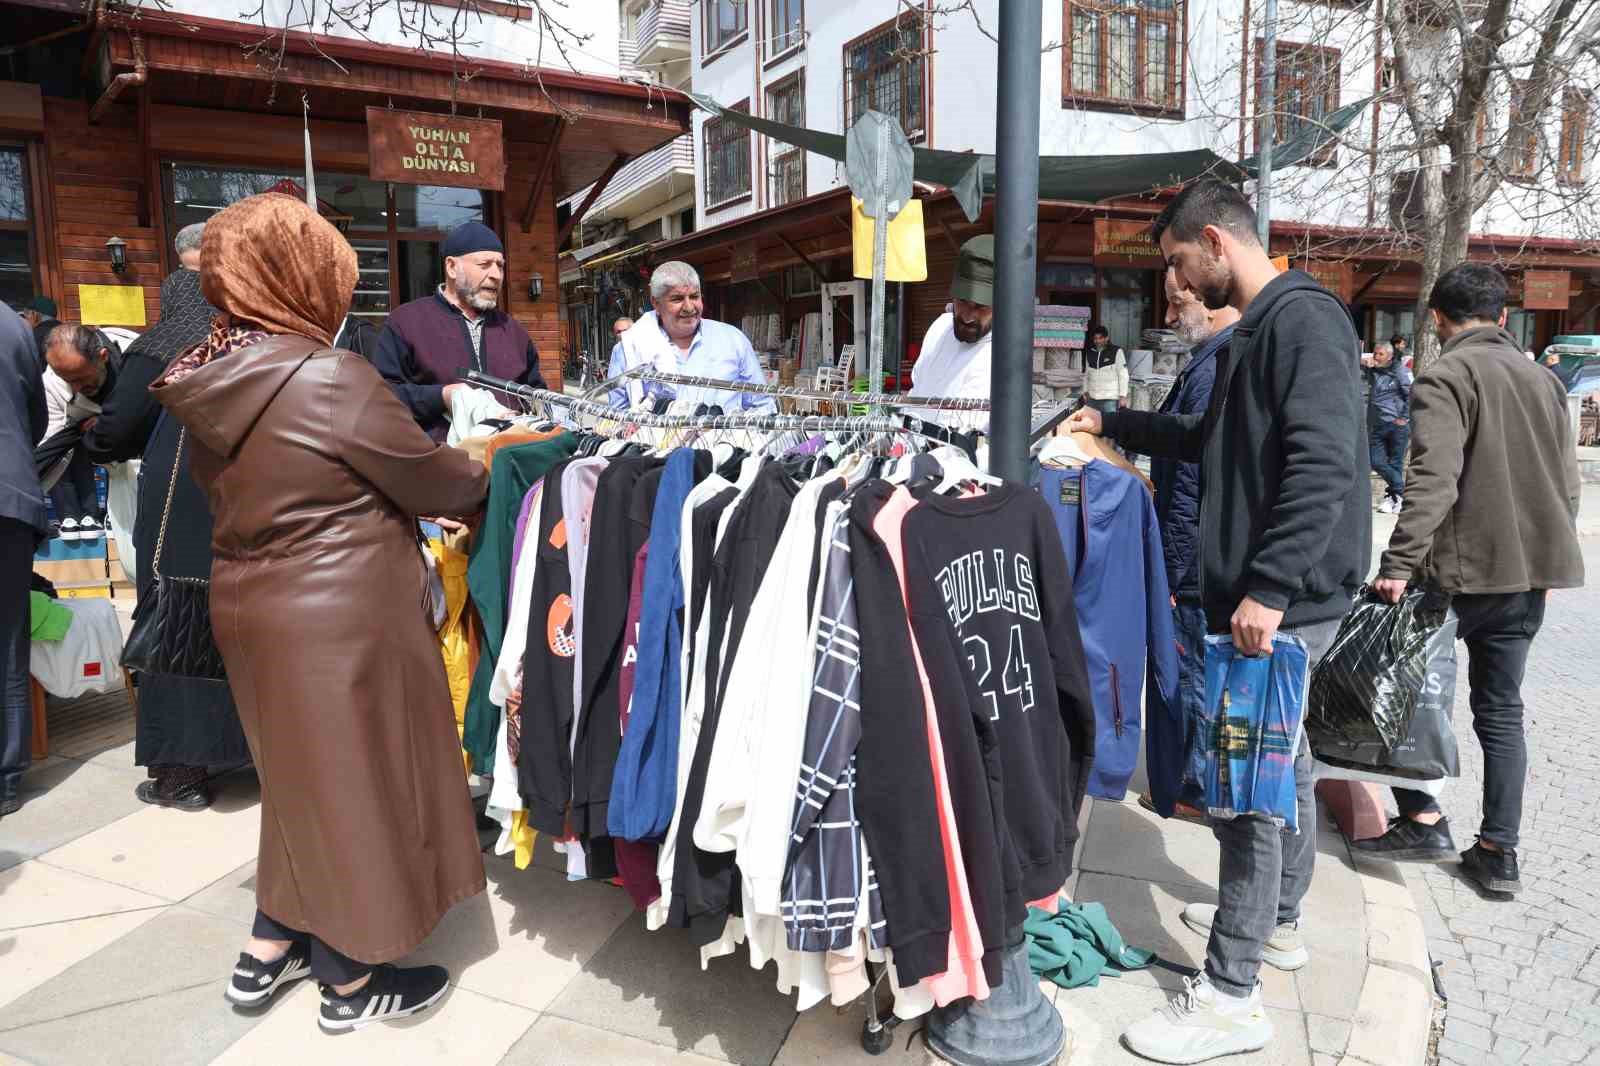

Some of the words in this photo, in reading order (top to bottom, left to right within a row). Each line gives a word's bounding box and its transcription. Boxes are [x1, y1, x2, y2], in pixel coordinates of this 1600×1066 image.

[408, 126, 471, 144] YUHAN
[415, 142, 465, 159] OLTA
[402, 155, 476, 174] DÜNYASI
